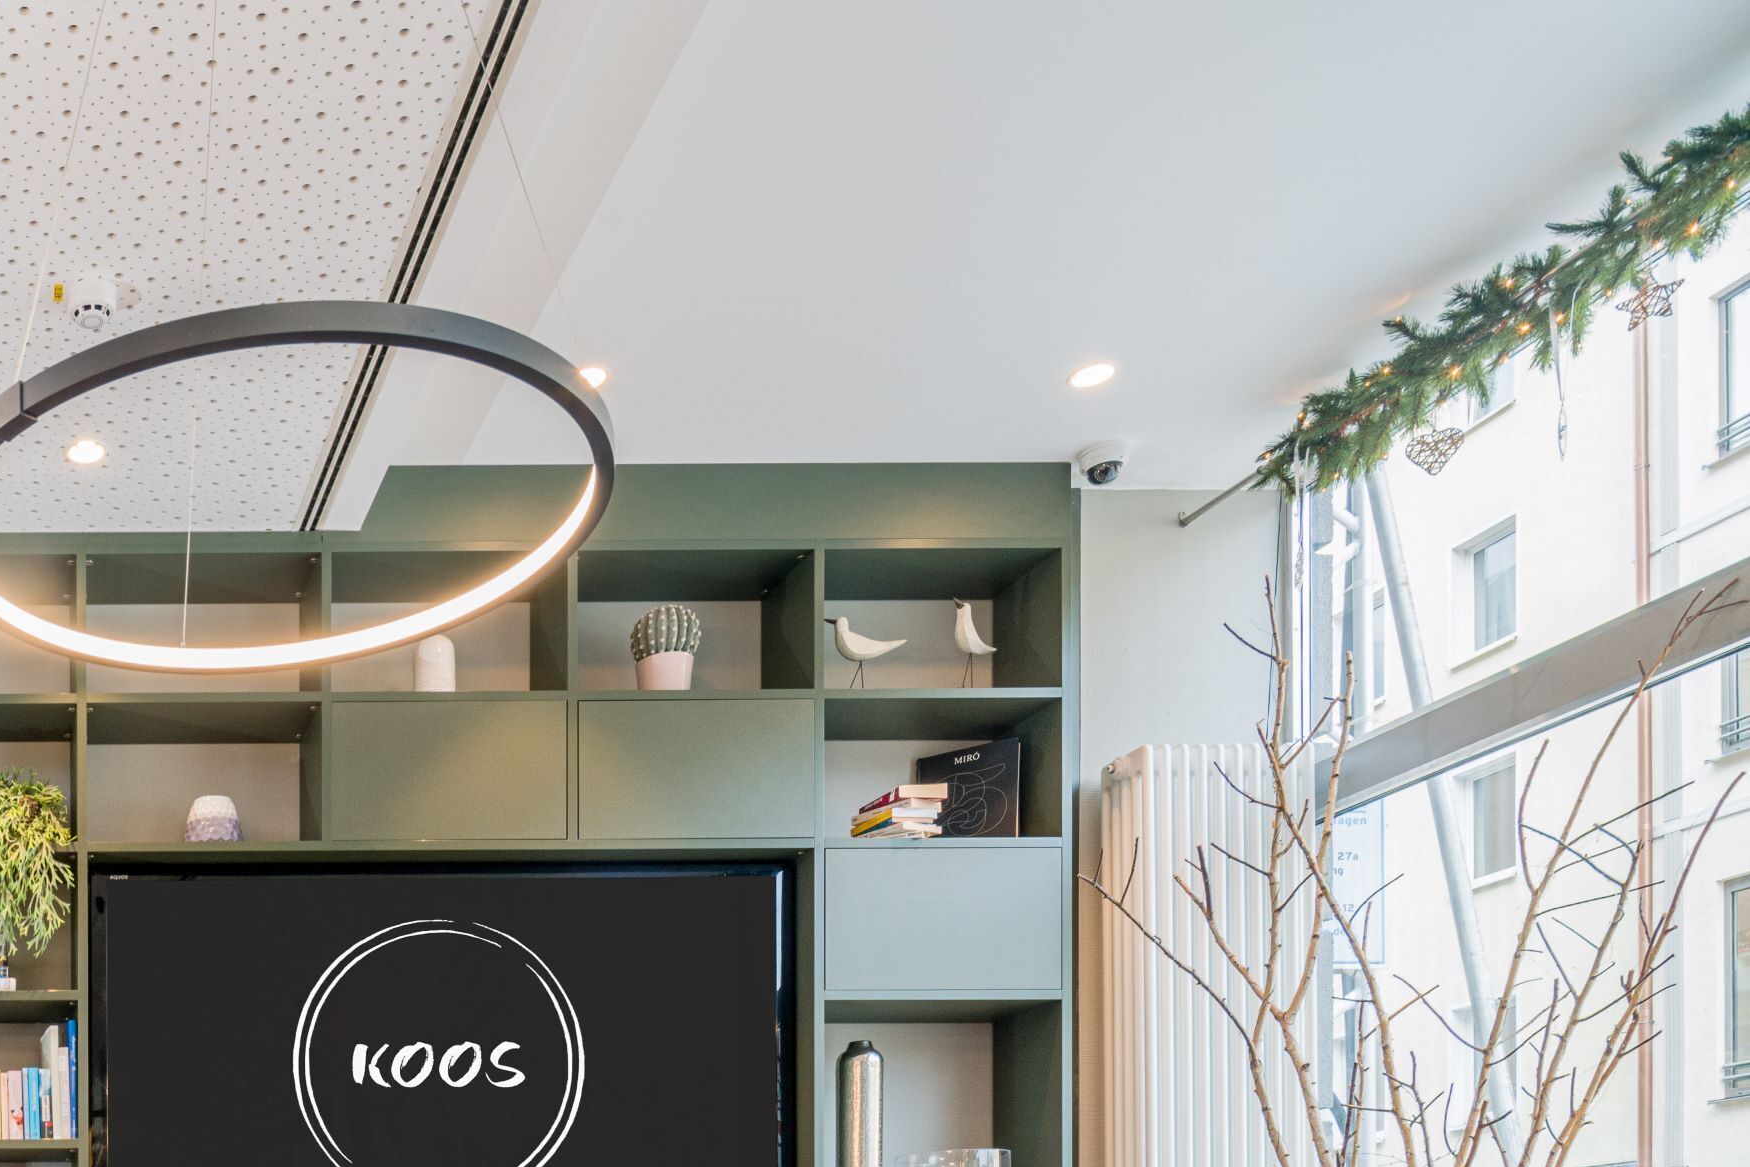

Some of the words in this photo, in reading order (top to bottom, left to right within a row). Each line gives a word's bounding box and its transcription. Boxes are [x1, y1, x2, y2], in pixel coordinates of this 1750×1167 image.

[954, 751, 980, 765] MIRÓ
[1337, 851, 1359, 861] 27a
[353, 1041, 525, 1087] KOOS
